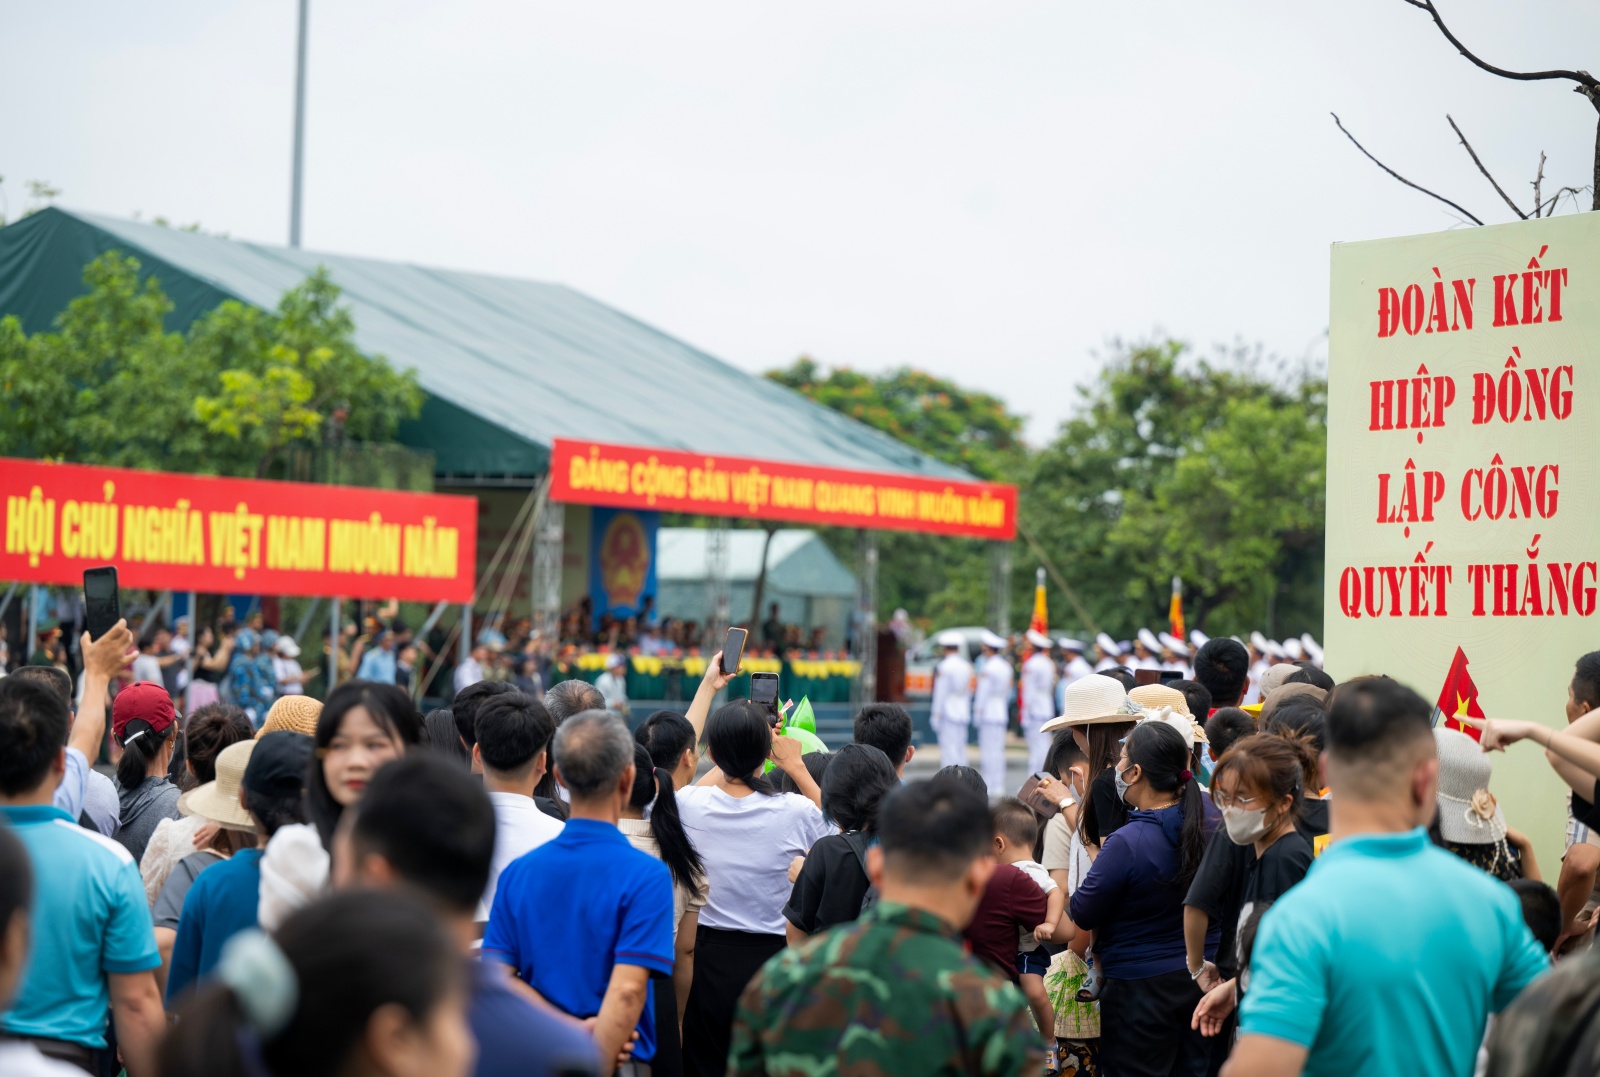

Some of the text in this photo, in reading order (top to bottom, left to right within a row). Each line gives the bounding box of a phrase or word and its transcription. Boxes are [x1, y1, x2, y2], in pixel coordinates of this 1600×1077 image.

[1377, 245, 1568, 339] ĐOÀN KẾT
[1368, 346, 1574, 445] HIỆP ĐỒNG
[569, 445, 630, 494] ĐẢNG
[631, 456, 688, 505] CỘNG
[689, 457, 730, 502] SẢN
[731, 466, 770, 513] VIỆT
[771, 475, 815, 510] NAM
[815, 480, 875, 517] QUANG
[876, 486, 917, 520] VINH
[1376, 453, 1559, 539] LẬP CÔNG
[5, 485, 56, 567] HỘI
[61, 480, 119, 560] CHỦ
[122, 499, 205, 565] NGHĨA
[209, 502, 265, 579] VIỆT
[266, 515, 326, 571] NAM
[328, 511, 401, 576] MUÔN
[402, 516, 459, 579] NĂM
[1338, 534, 1598, 619] QUYẾT THẮNG
